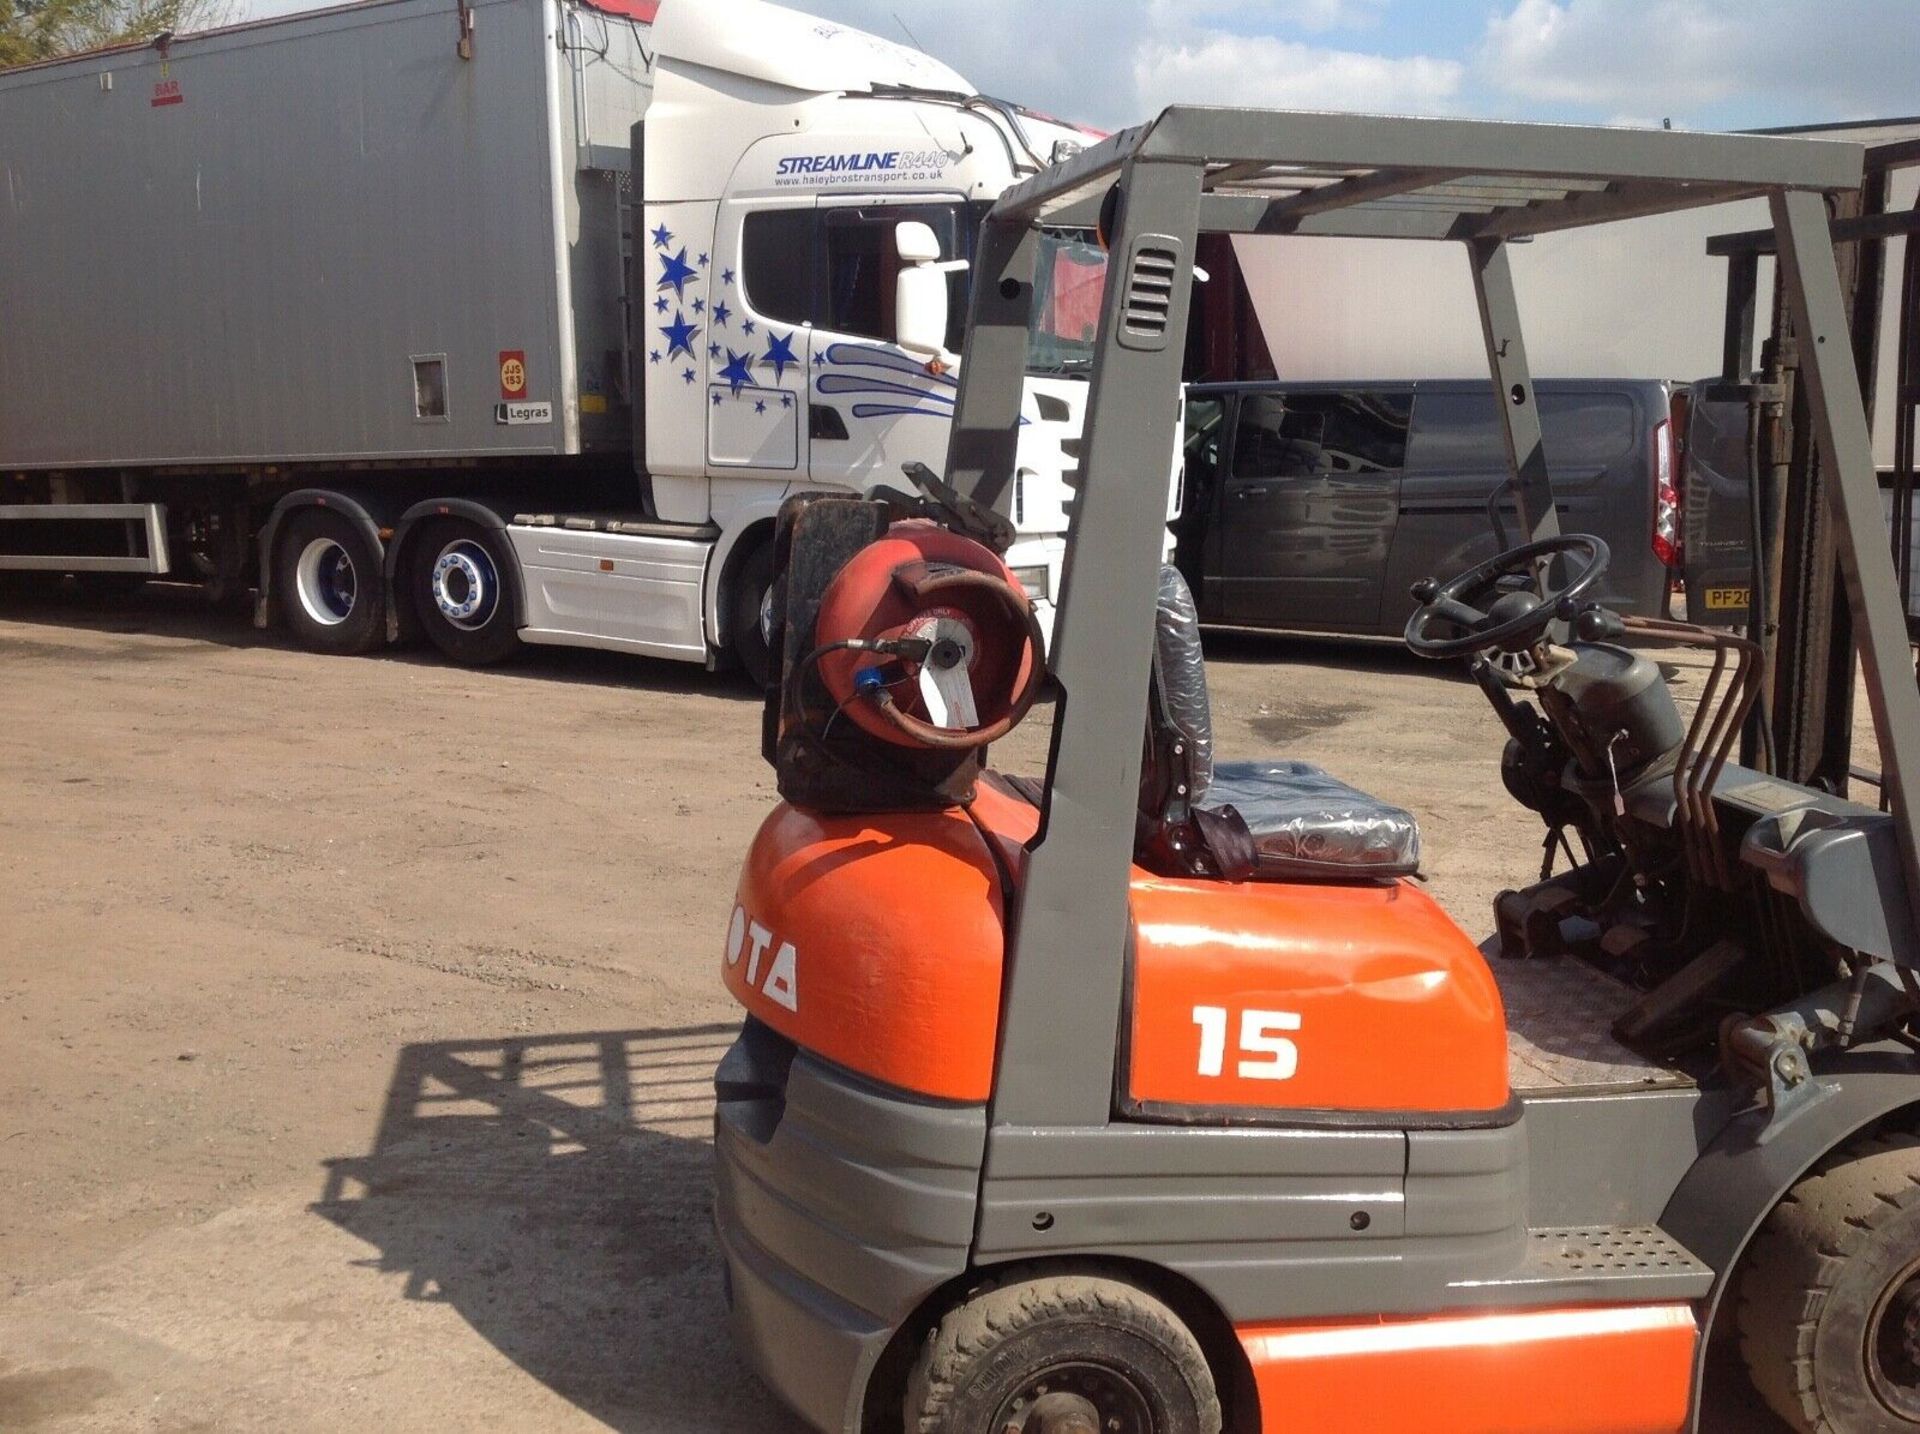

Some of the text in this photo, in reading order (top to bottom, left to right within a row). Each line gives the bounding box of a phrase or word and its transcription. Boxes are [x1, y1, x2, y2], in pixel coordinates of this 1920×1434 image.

[776, 151, 950, 175] STREAMLINE R440
[505, 376, 521, 385] 153
[510, 408, 548, 420] Legras
[1192, 1005, 1302, 1080] 15
